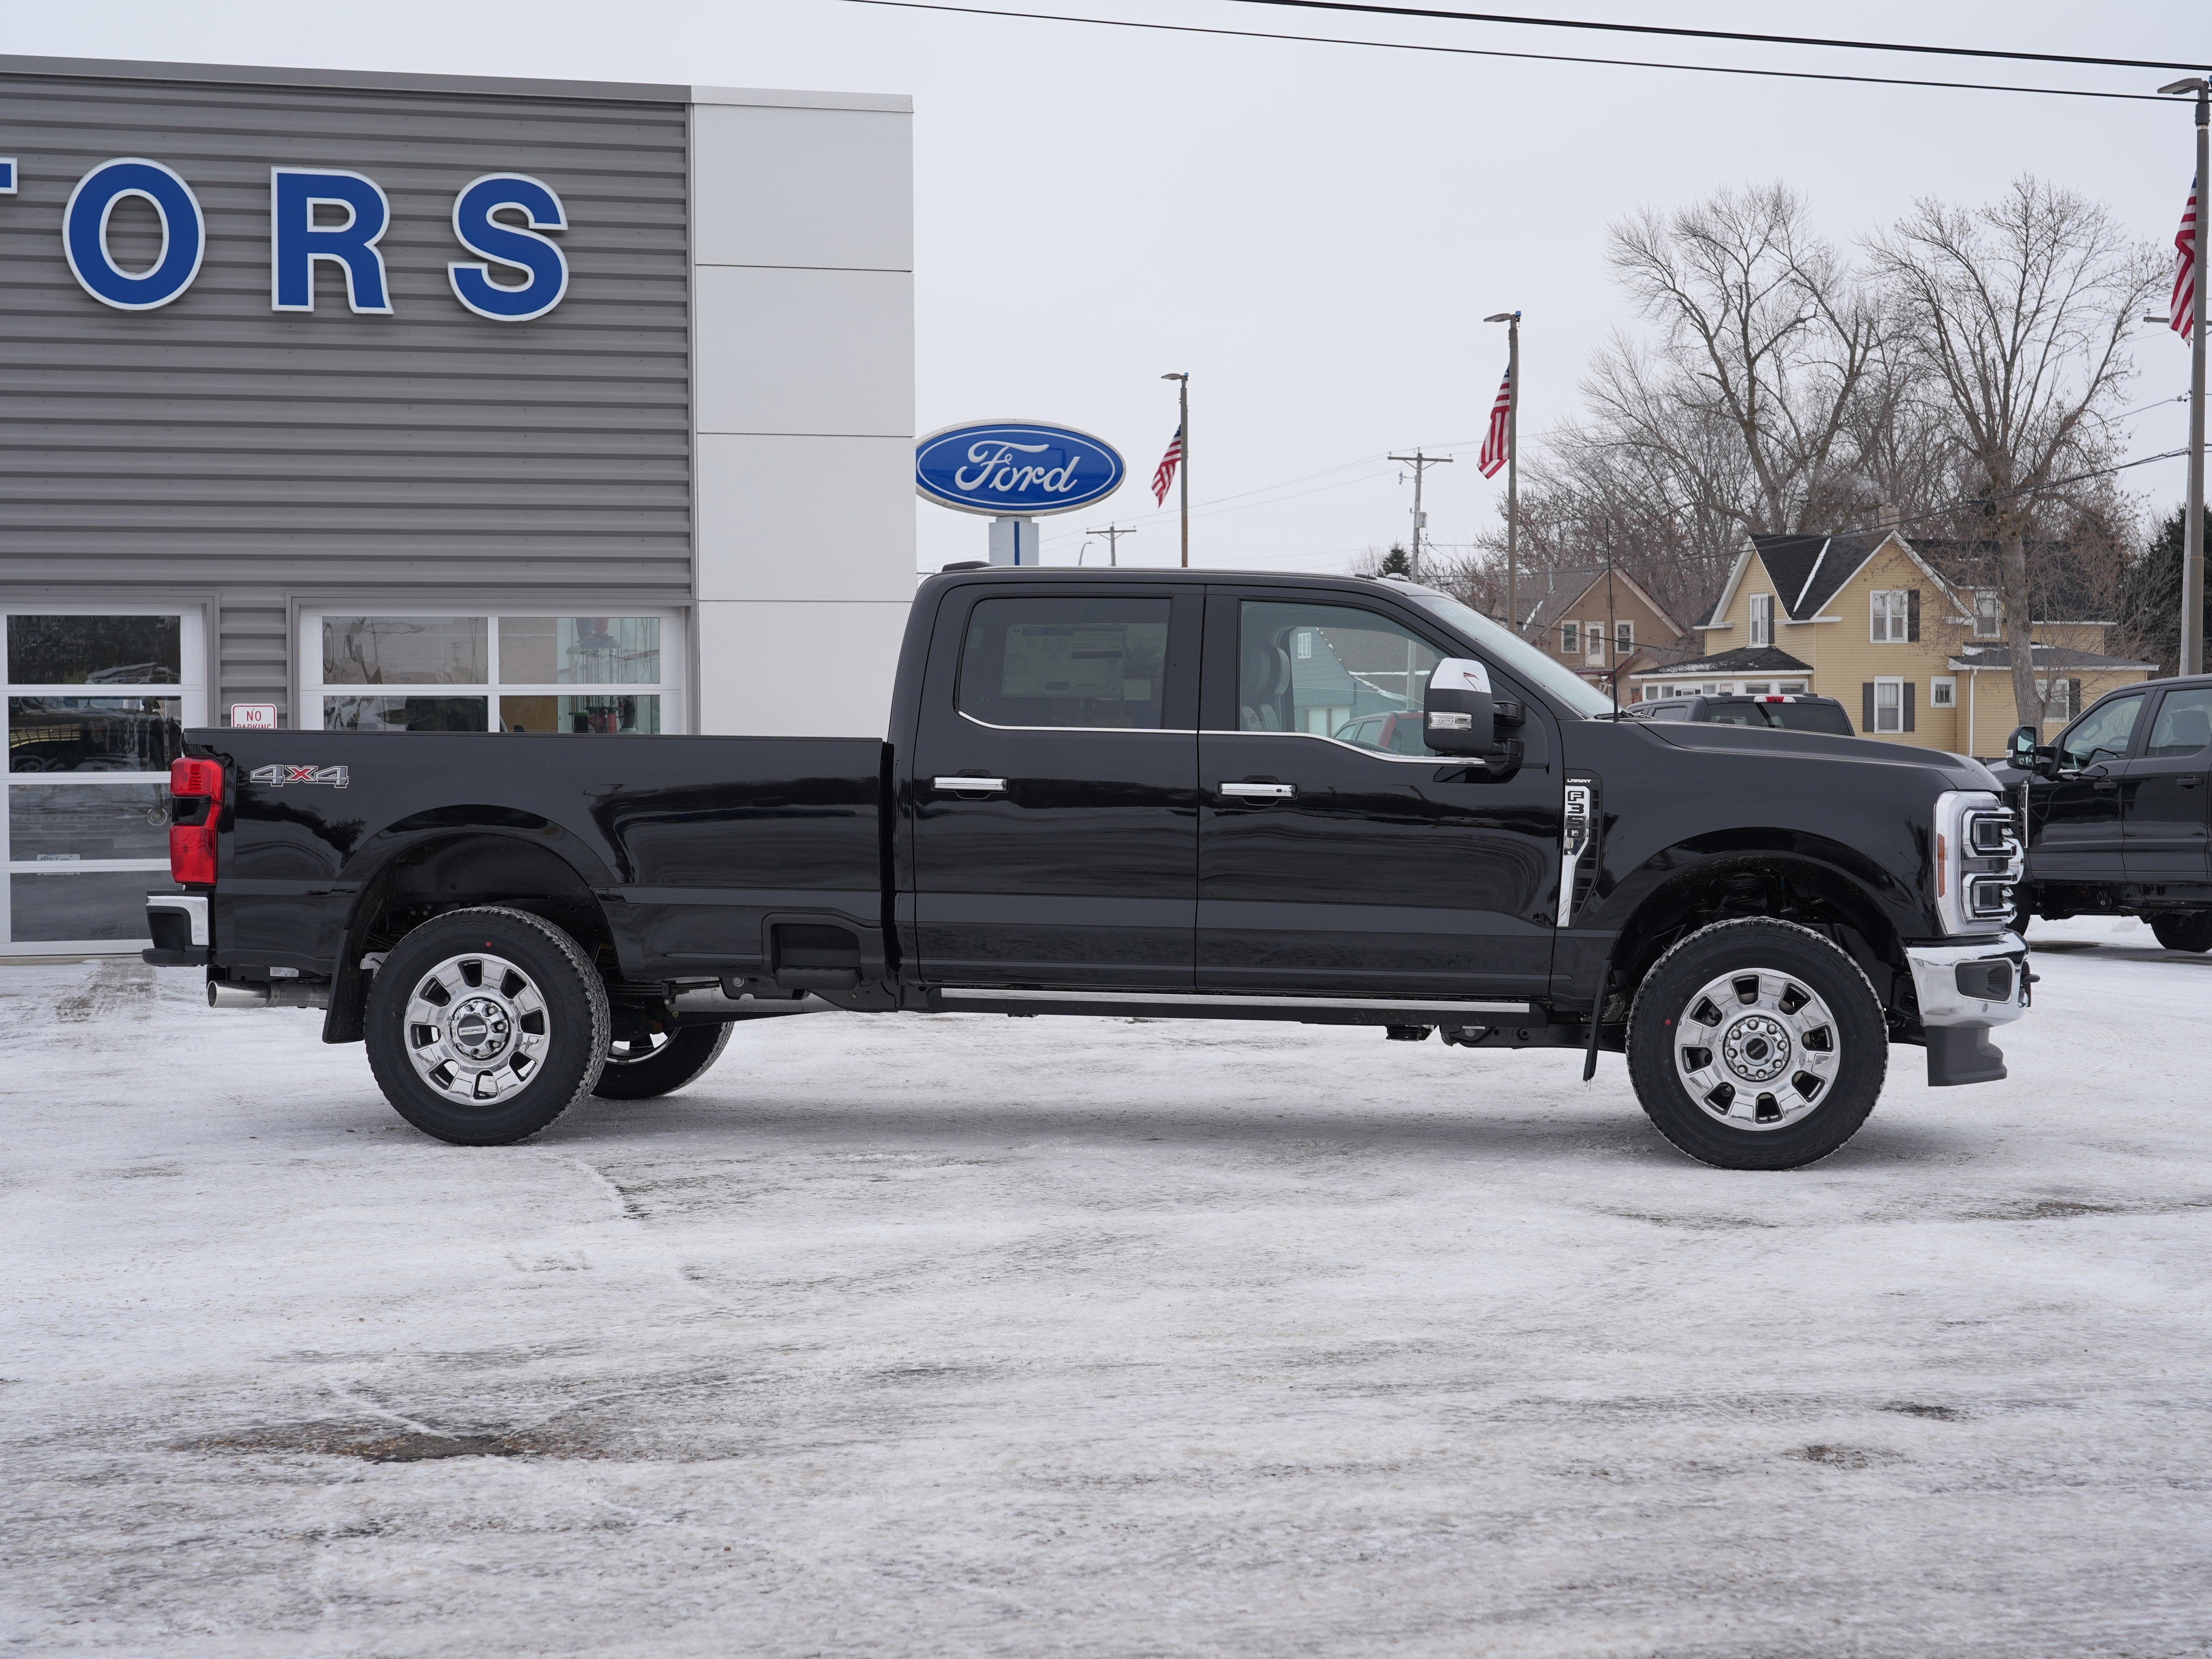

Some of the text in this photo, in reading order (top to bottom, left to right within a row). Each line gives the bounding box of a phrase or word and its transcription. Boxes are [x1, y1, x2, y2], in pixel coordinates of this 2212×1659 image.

[0, 157, 569, 321] ORS
[954, 440, 1081, 493] Ford
[246, 711, 261, 721] NO
